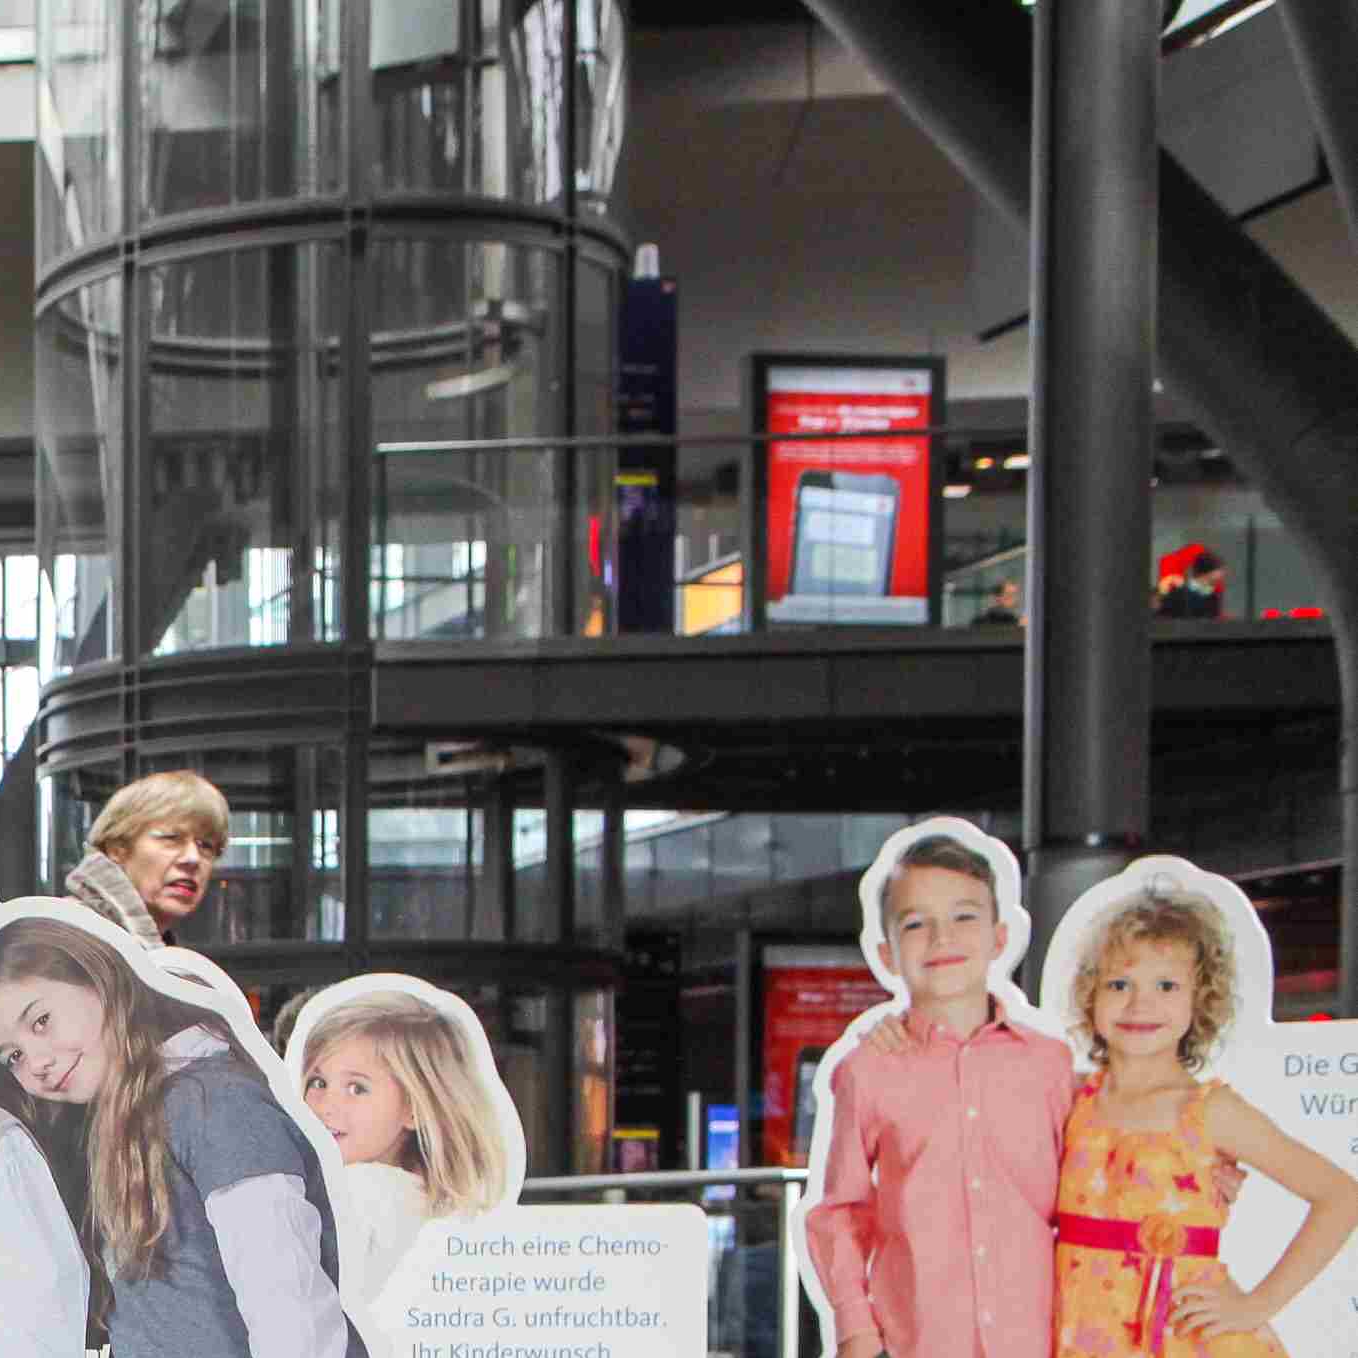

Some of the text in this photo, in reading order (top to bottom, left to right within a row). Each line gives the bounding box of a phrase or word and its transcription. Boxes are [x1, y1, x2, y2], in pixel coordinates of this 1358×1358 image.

[1284, 1054, 1330, 1077] Die
[446, 1235, 669, 1257] Durch eine Chemo-
[431, 1270, 606, 1294] therapie wurde
[407, 1307, 668, 1328] Sandra G. unfruchtbar.
